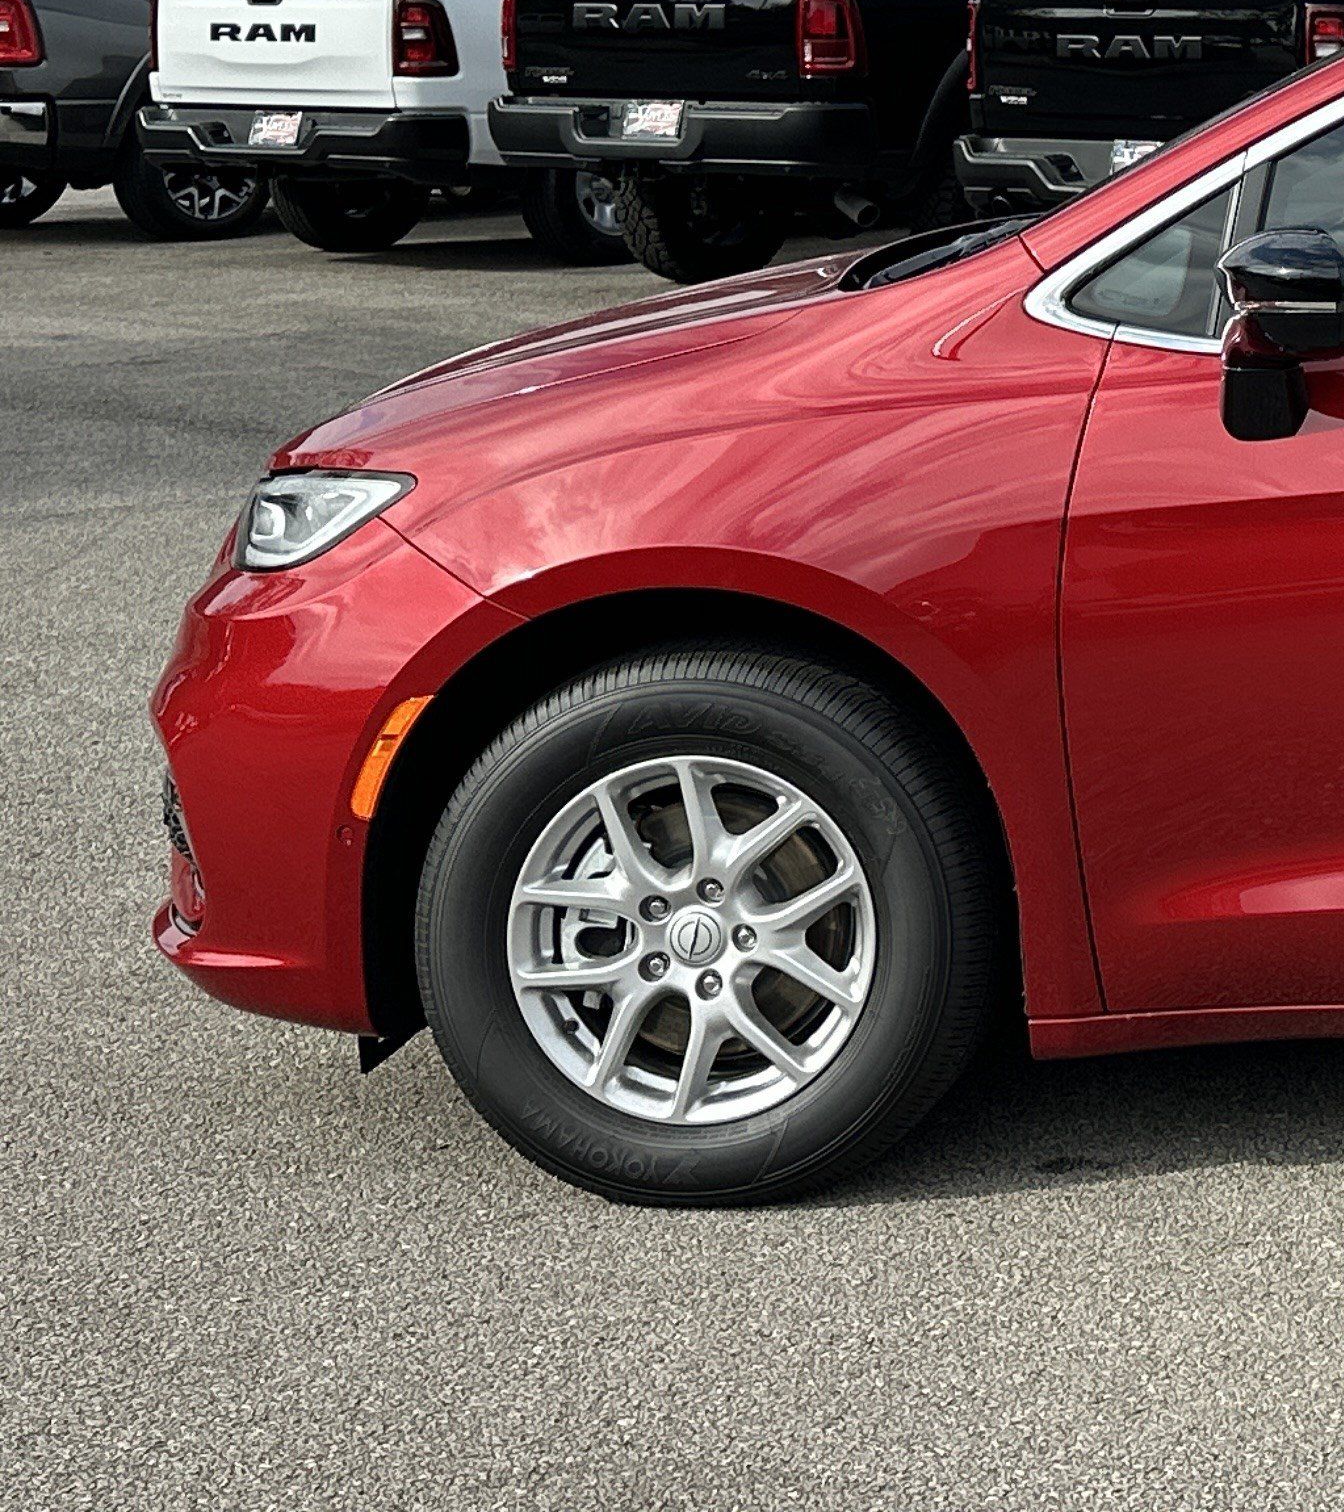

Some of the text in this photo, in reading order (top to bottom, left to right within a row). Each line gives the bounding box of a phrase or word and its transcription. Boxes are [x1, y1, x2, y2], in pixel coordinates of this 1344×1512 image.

[573, 3, 726, 30] RAM
[209, 23, 316, 43] RAM
[1056, 33, 1203, 59] RAM
